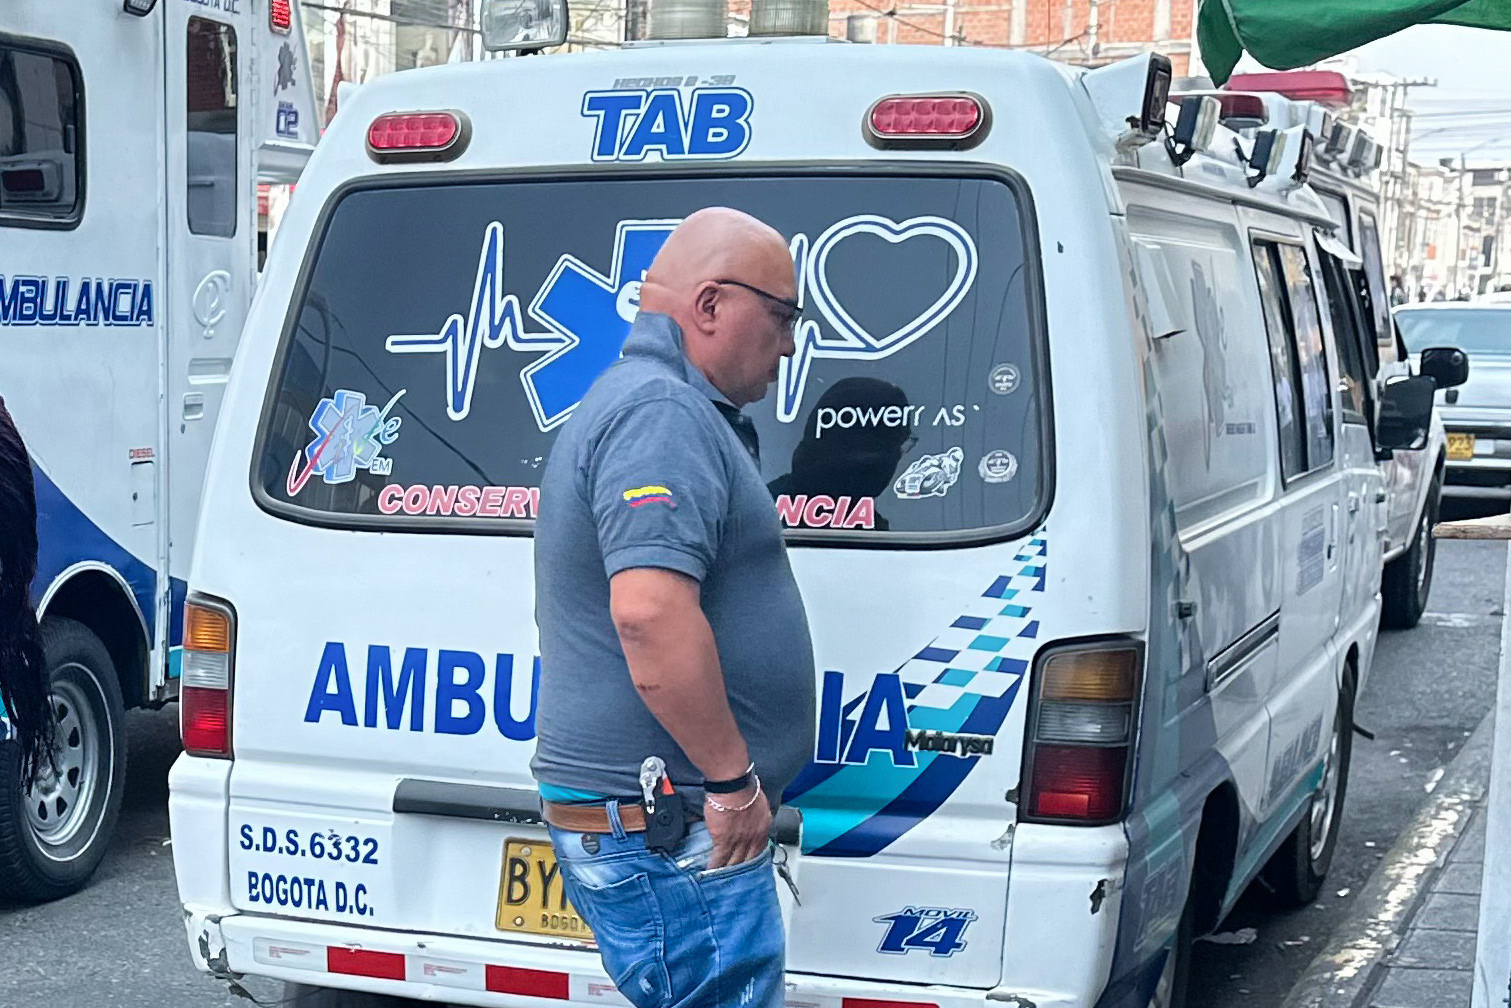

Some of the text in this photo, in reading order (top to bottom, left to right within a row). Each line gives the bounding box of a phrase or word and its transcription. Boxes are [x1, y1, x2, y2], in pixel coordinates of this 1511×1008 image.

[581, 86, 754, 162] TAB
[775, 494, 876, 529] NCIA
[239, 823, 379, 865] S.D.S.6332
[247, 870, 375, 917] BOGOTA D.C.
[903, 908, 974, 919] MOVIL
[873, 913, 968, 956] 14
